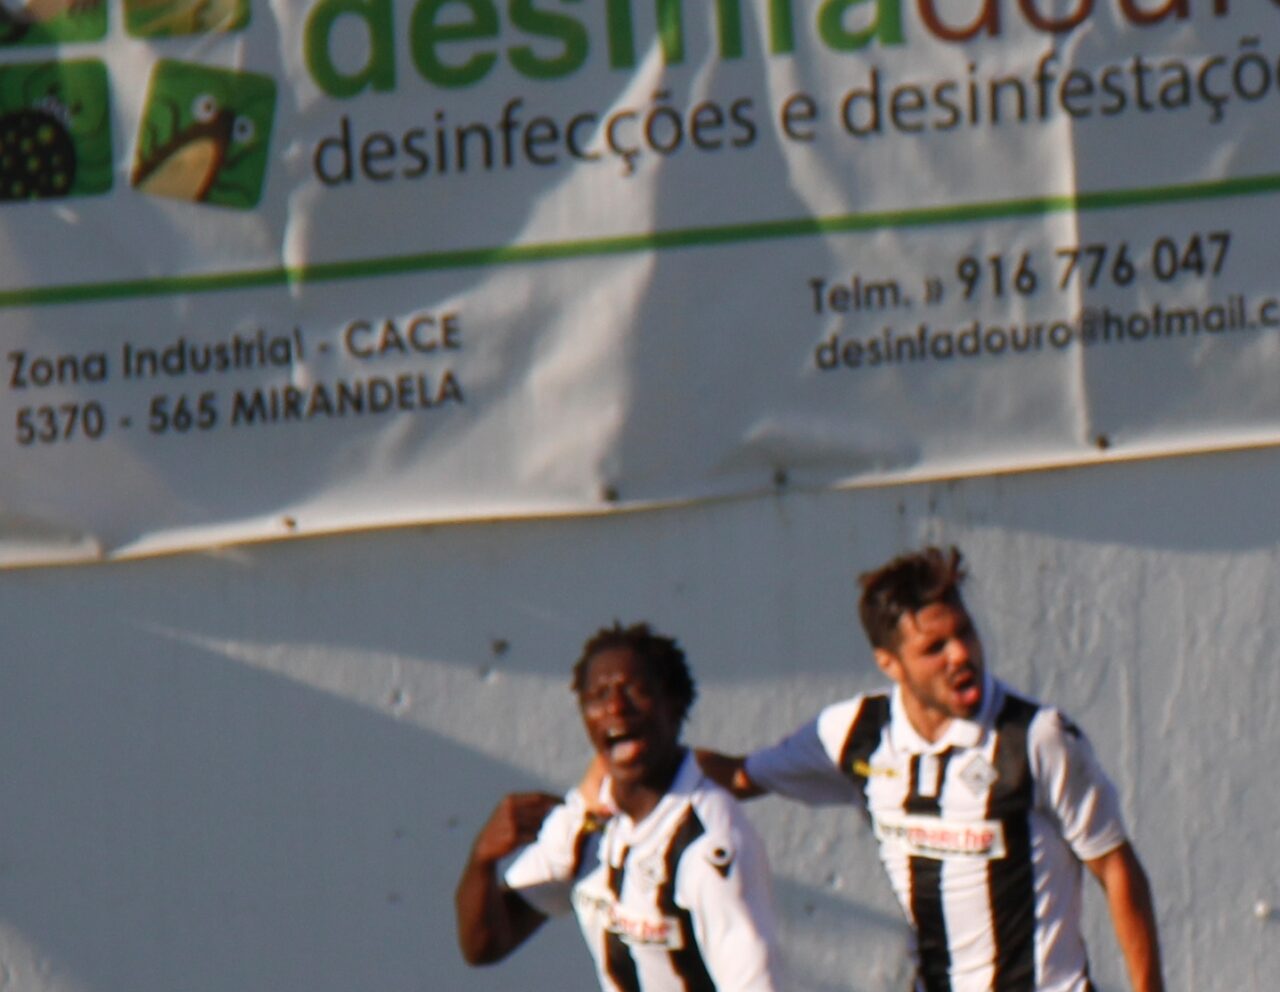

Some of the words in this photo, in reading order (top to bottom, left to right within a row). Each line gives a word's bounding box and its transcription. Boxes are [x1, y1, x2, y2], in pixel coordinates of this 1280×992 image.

[313, 88, 757, 187] desinfecções
[781, 91, 817, 142] e
[957, 249, 1037, 299] 916
[1056, 242, 1136, 292] 776
[1153, 231, 1231, 281] 047
[8, 351, 108, 391] Zona
[123, 325, 304, 380] Industrial
[343, 312, 462, 359] CACE
[16, 402, 106, 446] 5370
[149, 391, 218, 434] 565
[231, 368, 465, 426] MIRANDELA
